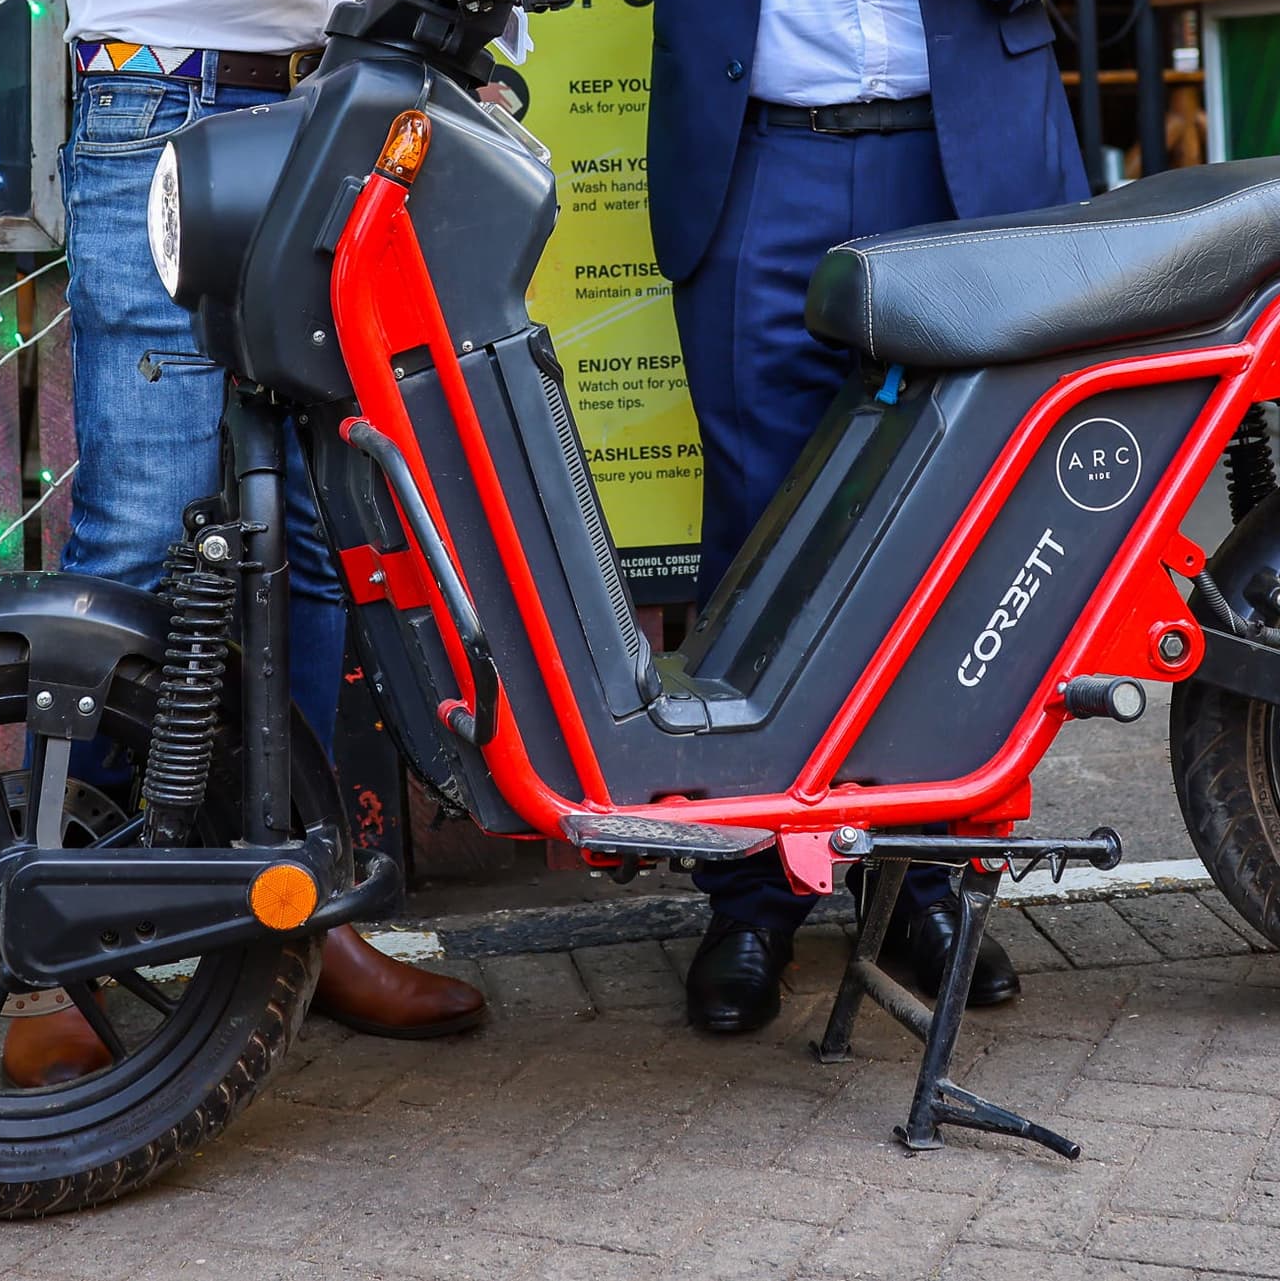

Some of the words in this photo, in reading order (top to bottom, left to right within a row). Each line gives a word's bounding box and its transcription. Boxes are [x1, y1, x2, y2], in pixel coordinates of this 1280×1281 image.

[569, 79, 613, 94] KEEP
[618, 78, 652, 93] YOU
[569, 101, 594, 114] Ask
[597, 100, 615, 113] for
[618, 102, 647, 116] your
[571, 159, 622, 174] WASH
[571, 180, 608, 194] Wash
[572, 199, 596, 212] and
[604, 200, 640, 211] water
[575, 263, 660, 279] PRACTISE
[575, 285, 631, 300] Maintain
[635, 287, 642, 297] a
[578, 357, 632, 373] ENJOY
[637, 355, 682, 370] RESP
[578, 379, 619, 393] Watch
[622, 379, 644, 391] out
[647, 377, 665, 389] for
[579, 398, 614, 411] these
[618, 396, 645, 410] tips.
[584, 445, 672, 462] CASHLESS
[1068, 446, 1130, 470] ARC
[592, 472, 625, 483] nsure
[629, 470, 652, 483] you
[656, 466, 691, 479] make
[1088, 471, 1111, 481] RIDE
[621, 556, 663, 568] ALCOHOL
[630, 567, 654, 578] SALE
[657, 566, 669, 576] TO
[957, 527, 1065, 687] CORBETT
